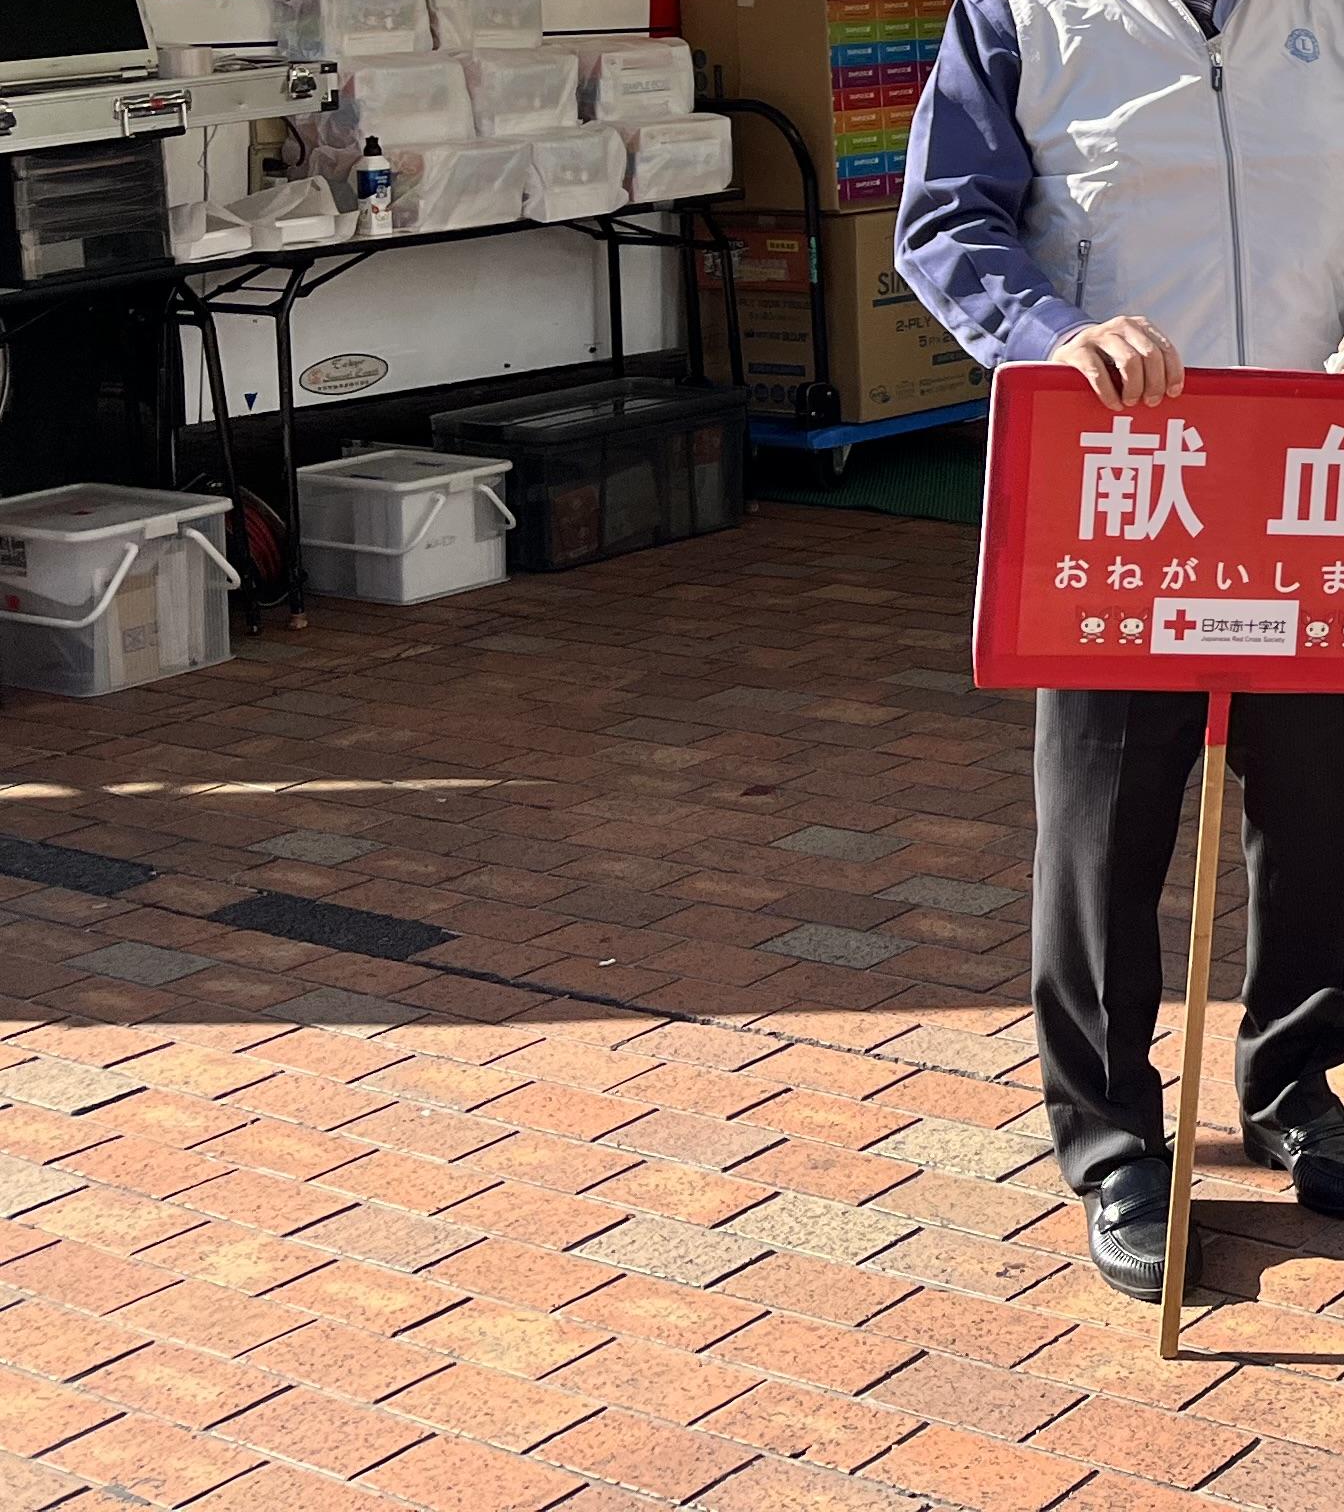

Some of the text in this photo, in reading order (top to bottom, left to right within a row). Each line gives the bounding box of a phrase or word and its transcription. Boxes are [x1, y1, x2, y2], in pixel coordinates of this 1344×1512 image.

[895, 316, 931, 332] 2-PLY
[1201, 618, 1287, 634] 日本赤十字社
